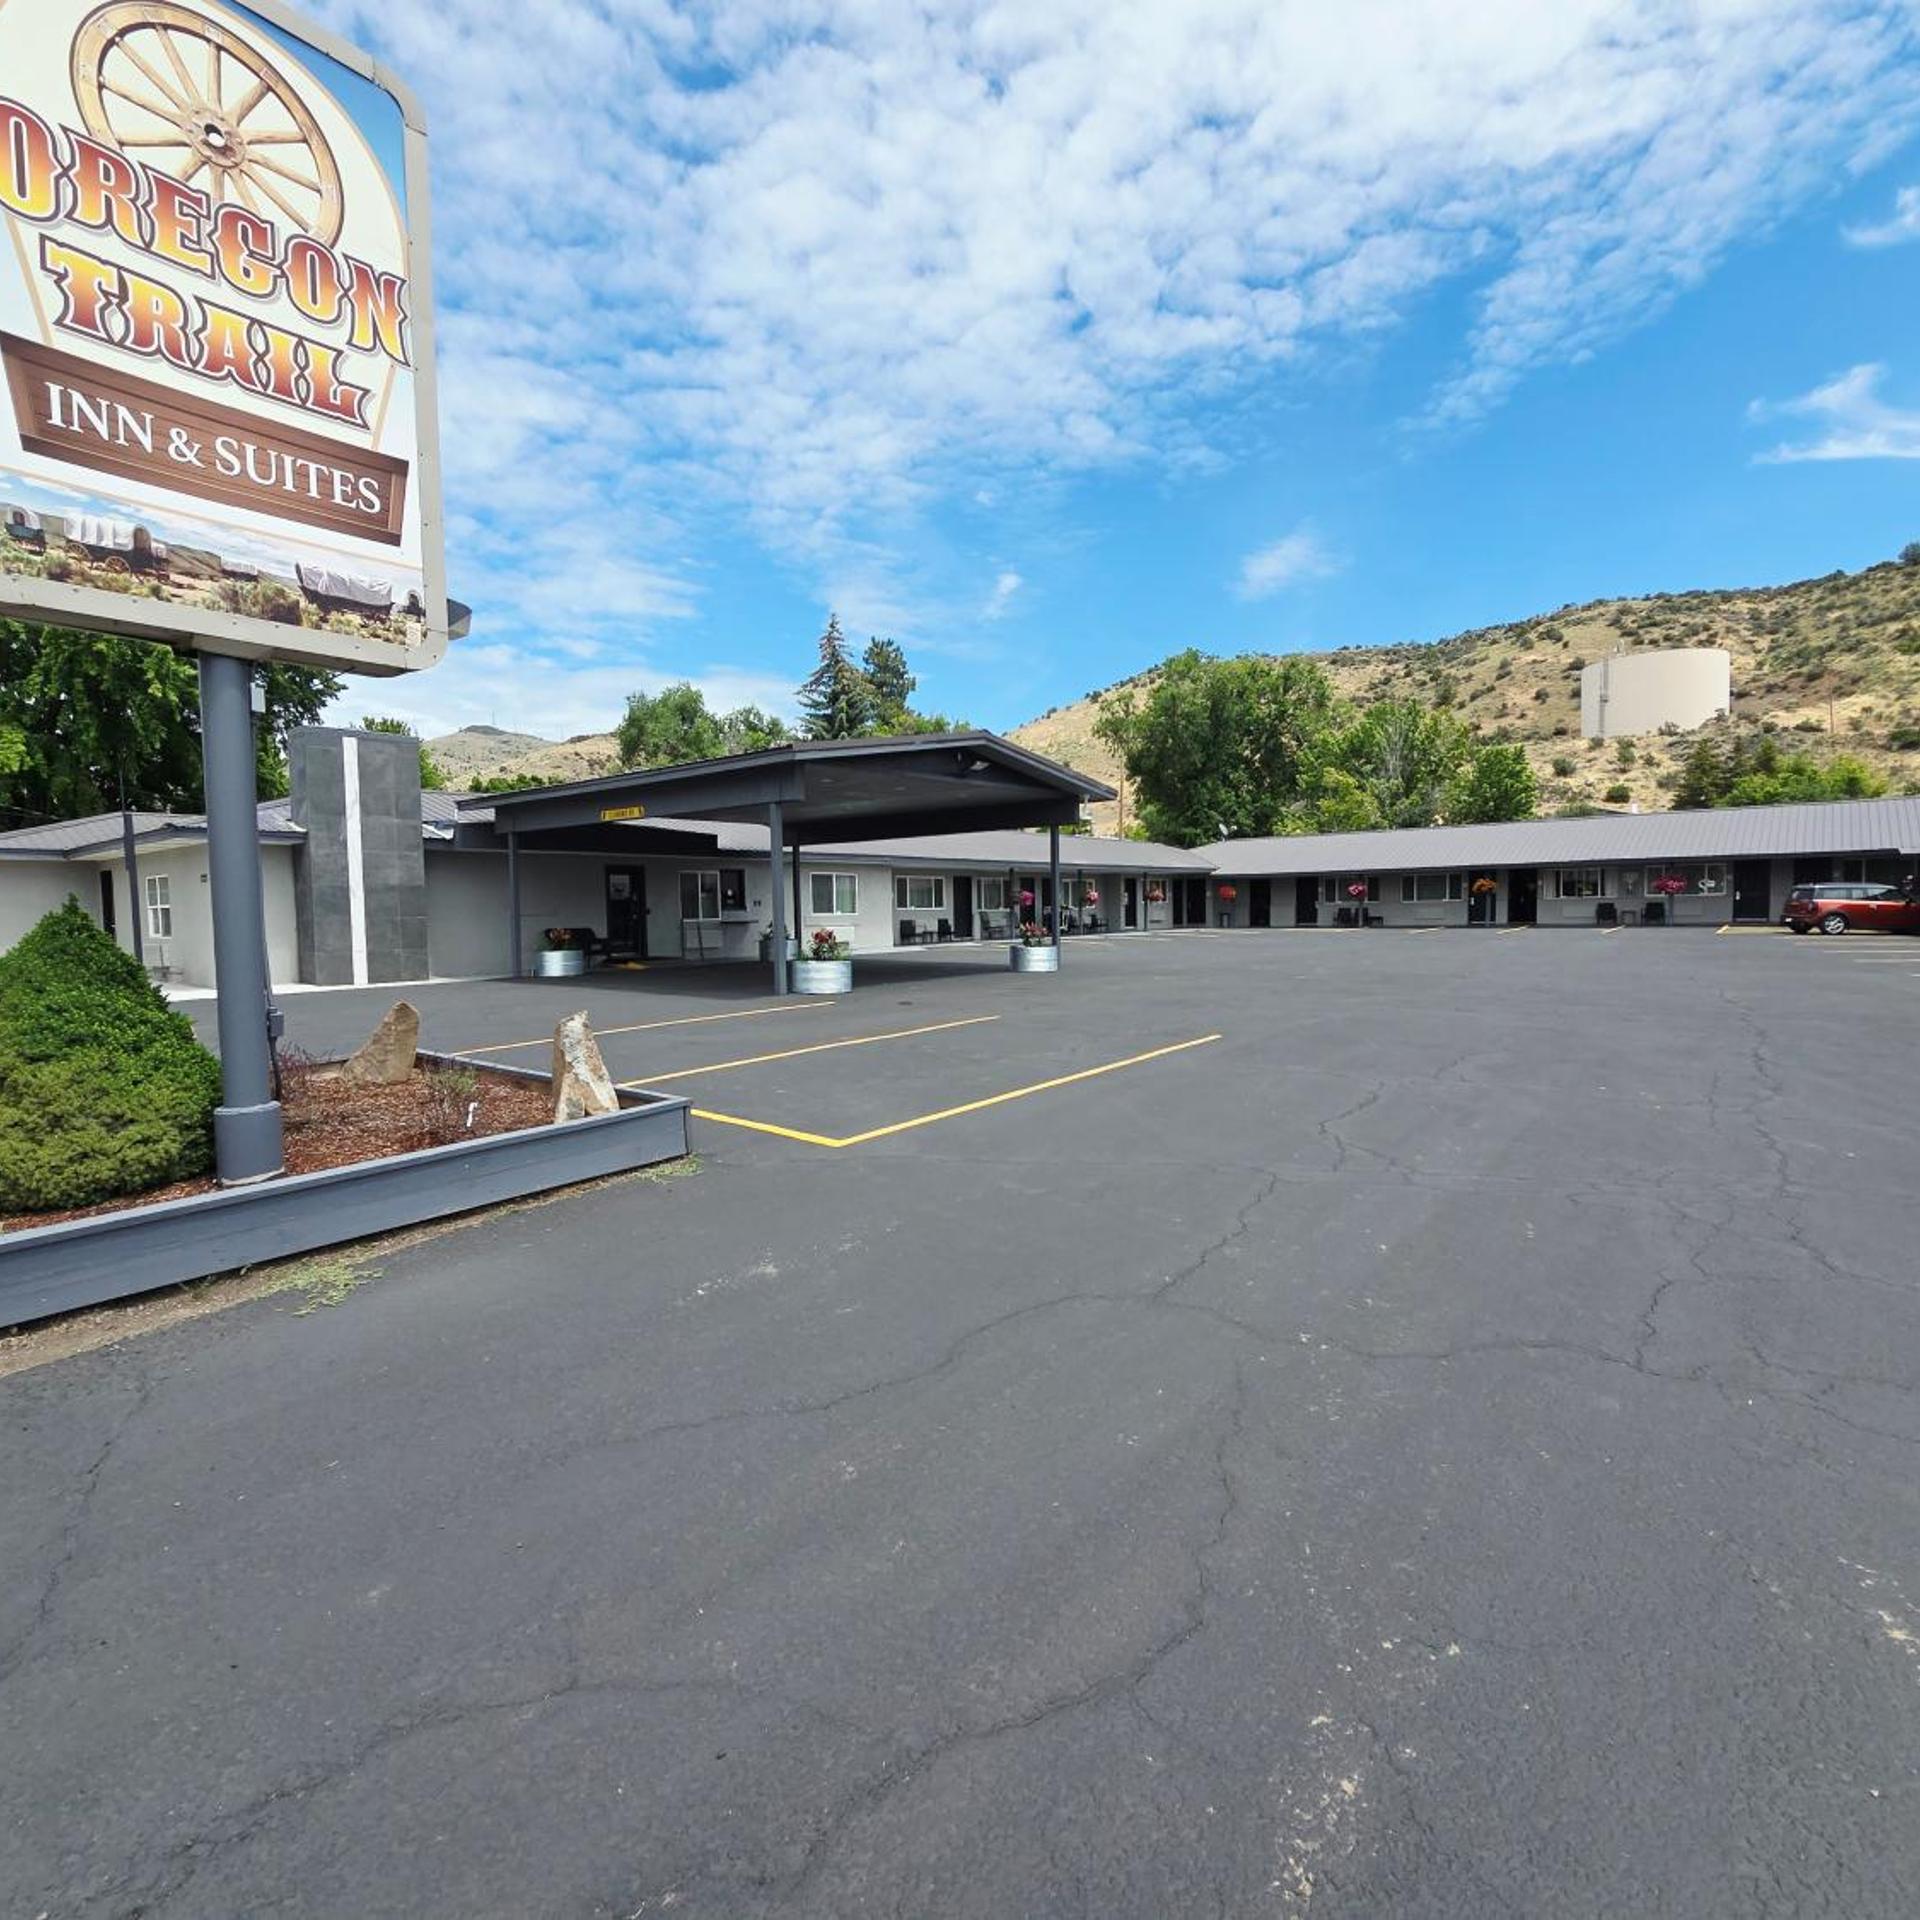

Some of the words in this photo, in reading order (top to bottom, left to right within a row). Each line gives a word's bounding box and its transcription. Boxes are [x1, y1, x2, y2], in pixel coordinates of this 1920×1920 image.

[0, 96, 411, 367] OREGON
[39, 232, 370, 430] TRAIL
[44, 381, 155, 454] INN
[167, 427, 206, 469] &
[213, 436, 382, 514] SUITES
